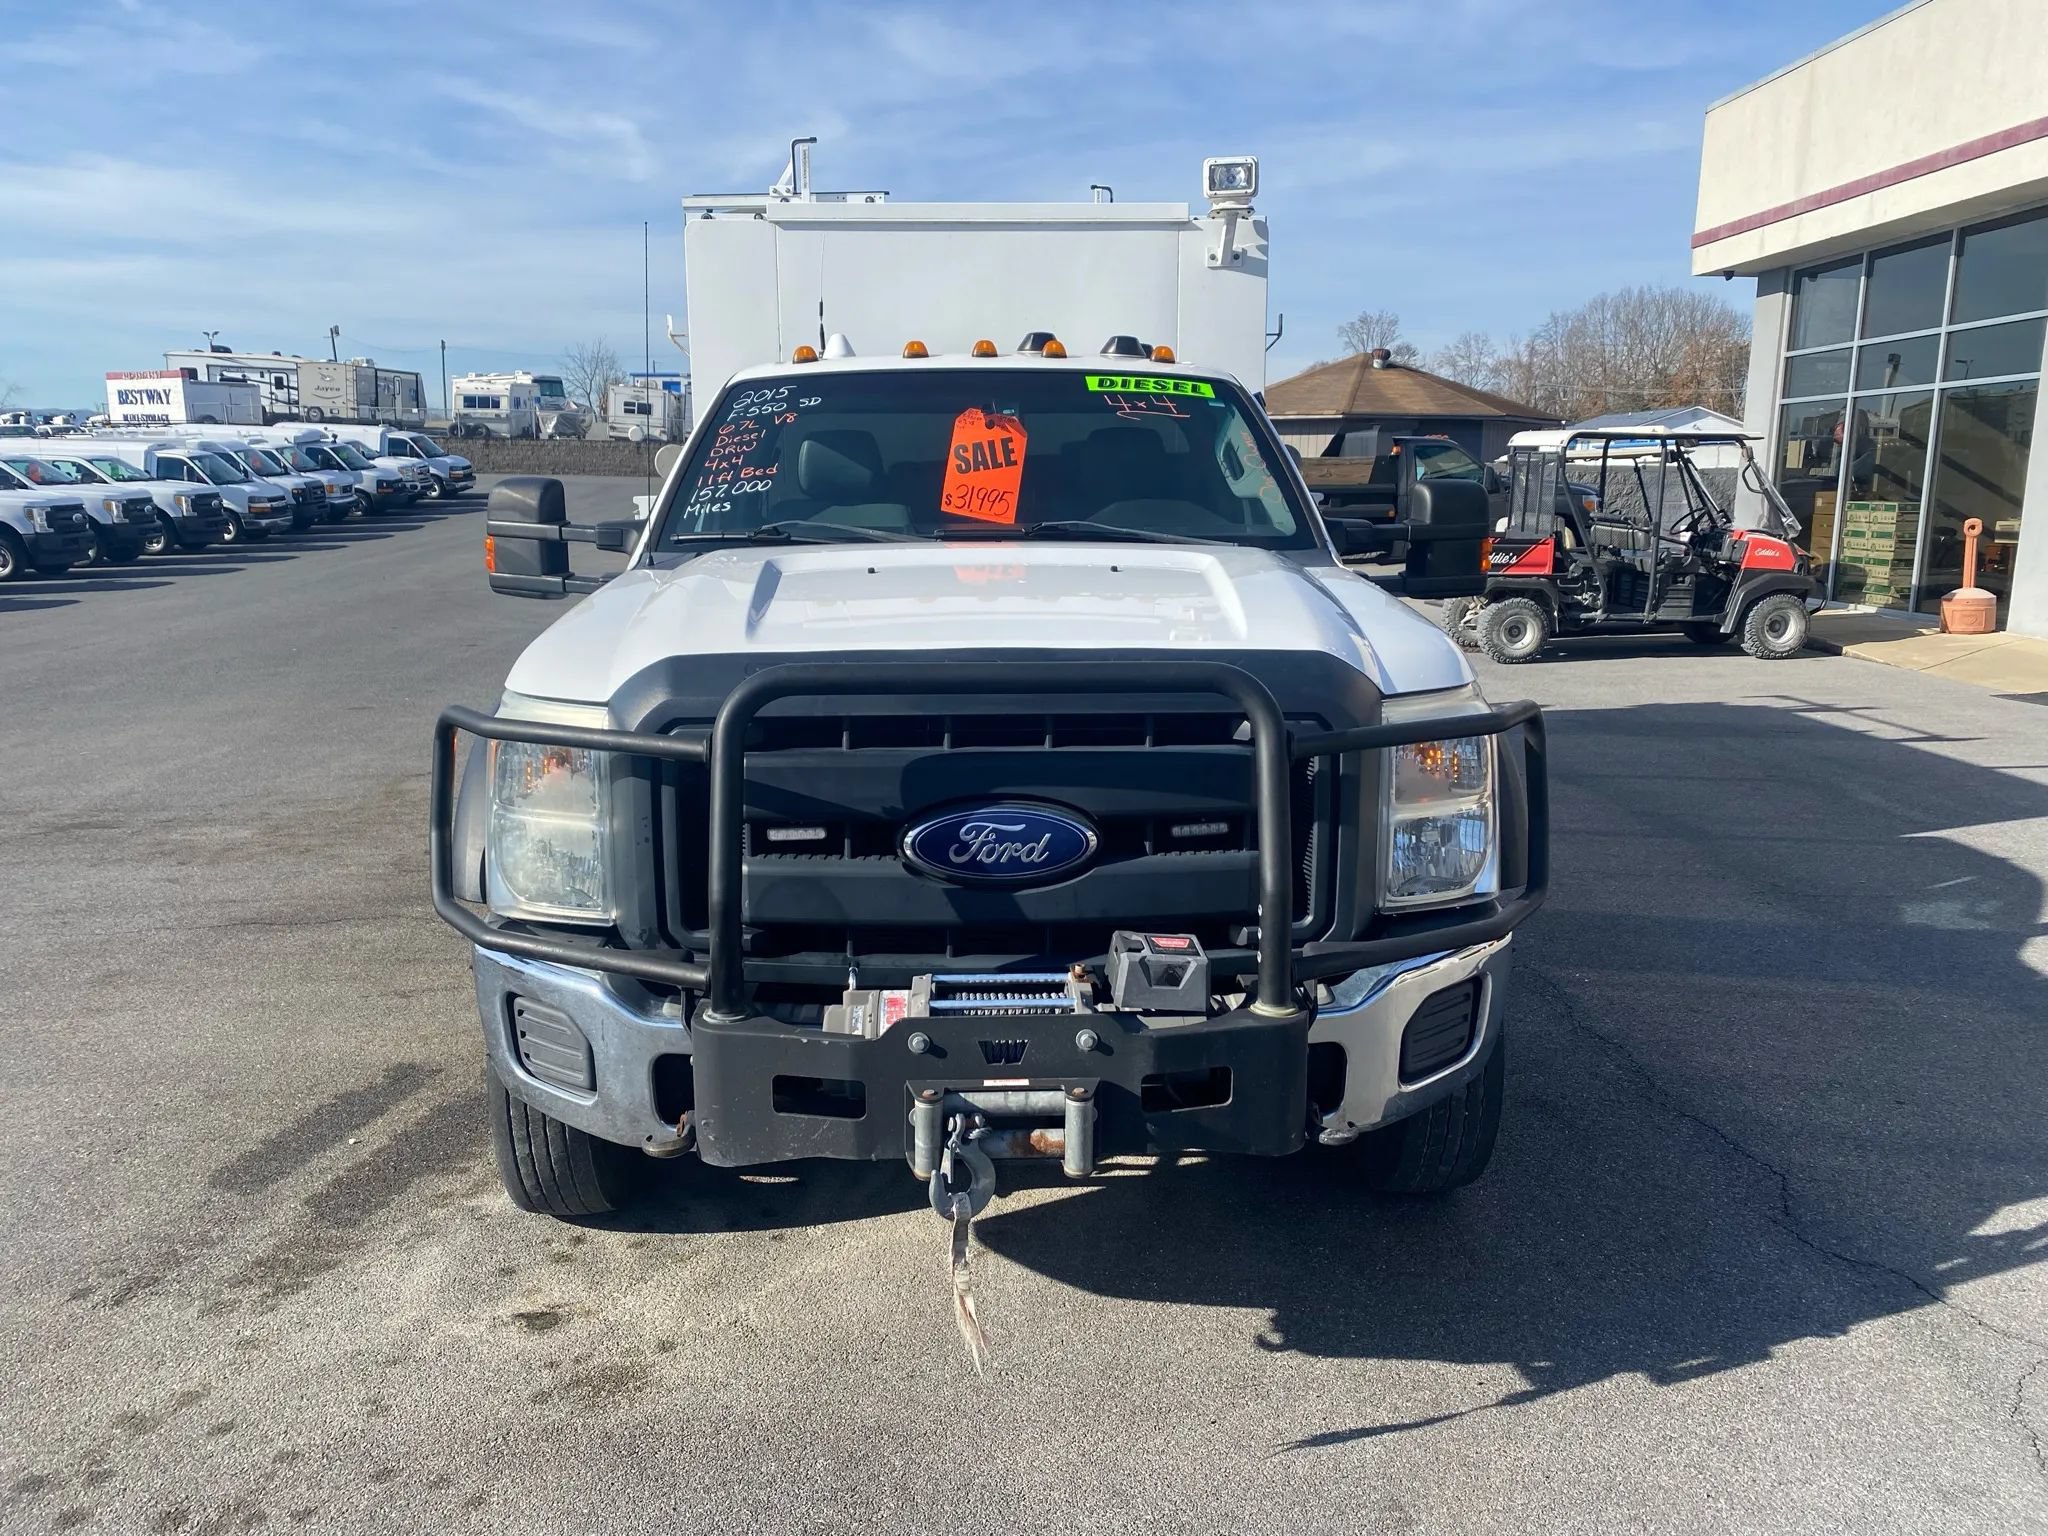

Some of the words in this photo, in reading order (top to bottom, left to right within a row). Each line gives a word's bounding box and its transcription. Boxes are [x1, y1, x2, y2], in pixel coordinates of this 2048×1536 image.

[1097, 378, 1206, 395] DIESEL
[117, 388, 171, 406] BESTWAY
[733, 385, 797, 409] 2015
[799, 396, 822, 407] SD
[774, 412, 798, 425] V8
[715, 429, 766, 448] Diesel
[710, 441, 757, 457] DRW
[953, 436, 1018, 475] SALE
[740, 462, 779, 478] Bed
[683, 501, 731, 519] Miles
[949, 822, 1052, 864] Ford
